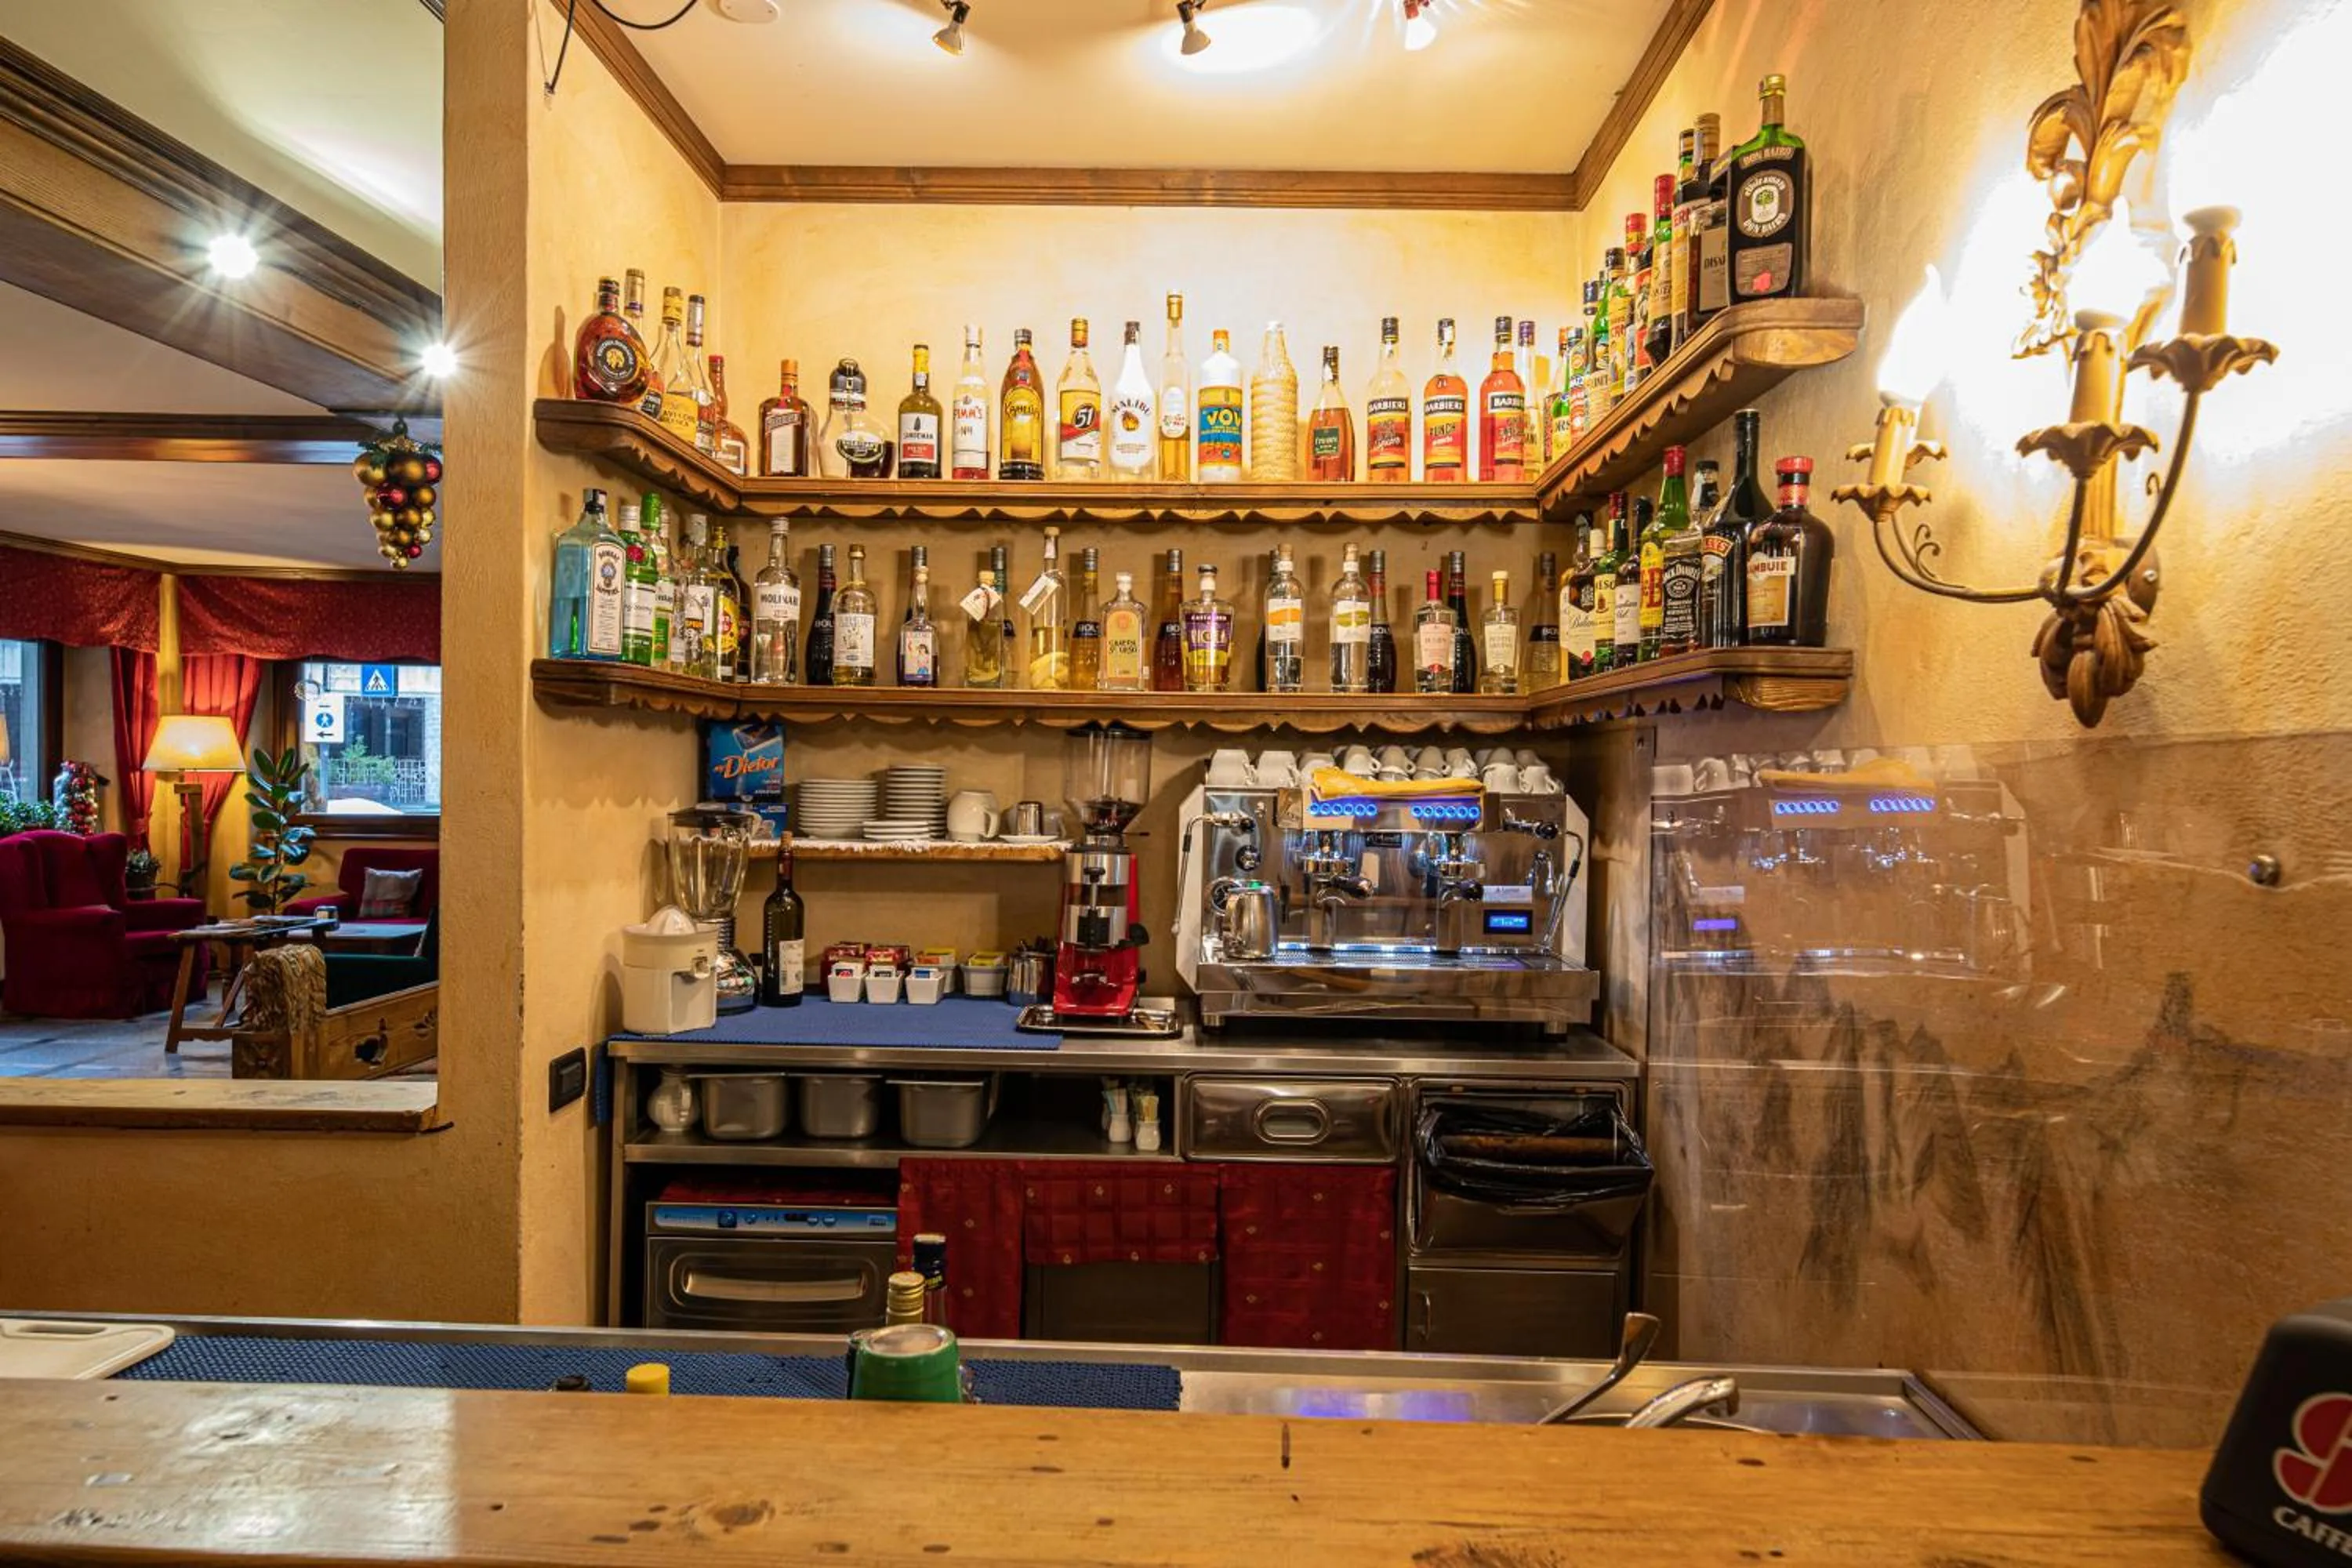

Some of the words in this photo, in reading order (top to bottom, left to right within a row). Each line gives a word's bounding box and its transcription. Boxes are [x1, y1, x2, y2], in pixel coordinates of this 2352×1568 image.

[1111, 398, 1152, 416] MALIBU
[1368, 401, 1406, 412] BARBIERI
[1425, 401, 1463, 413] BARBIERI
[1075, 408, 1094, 428] 51
